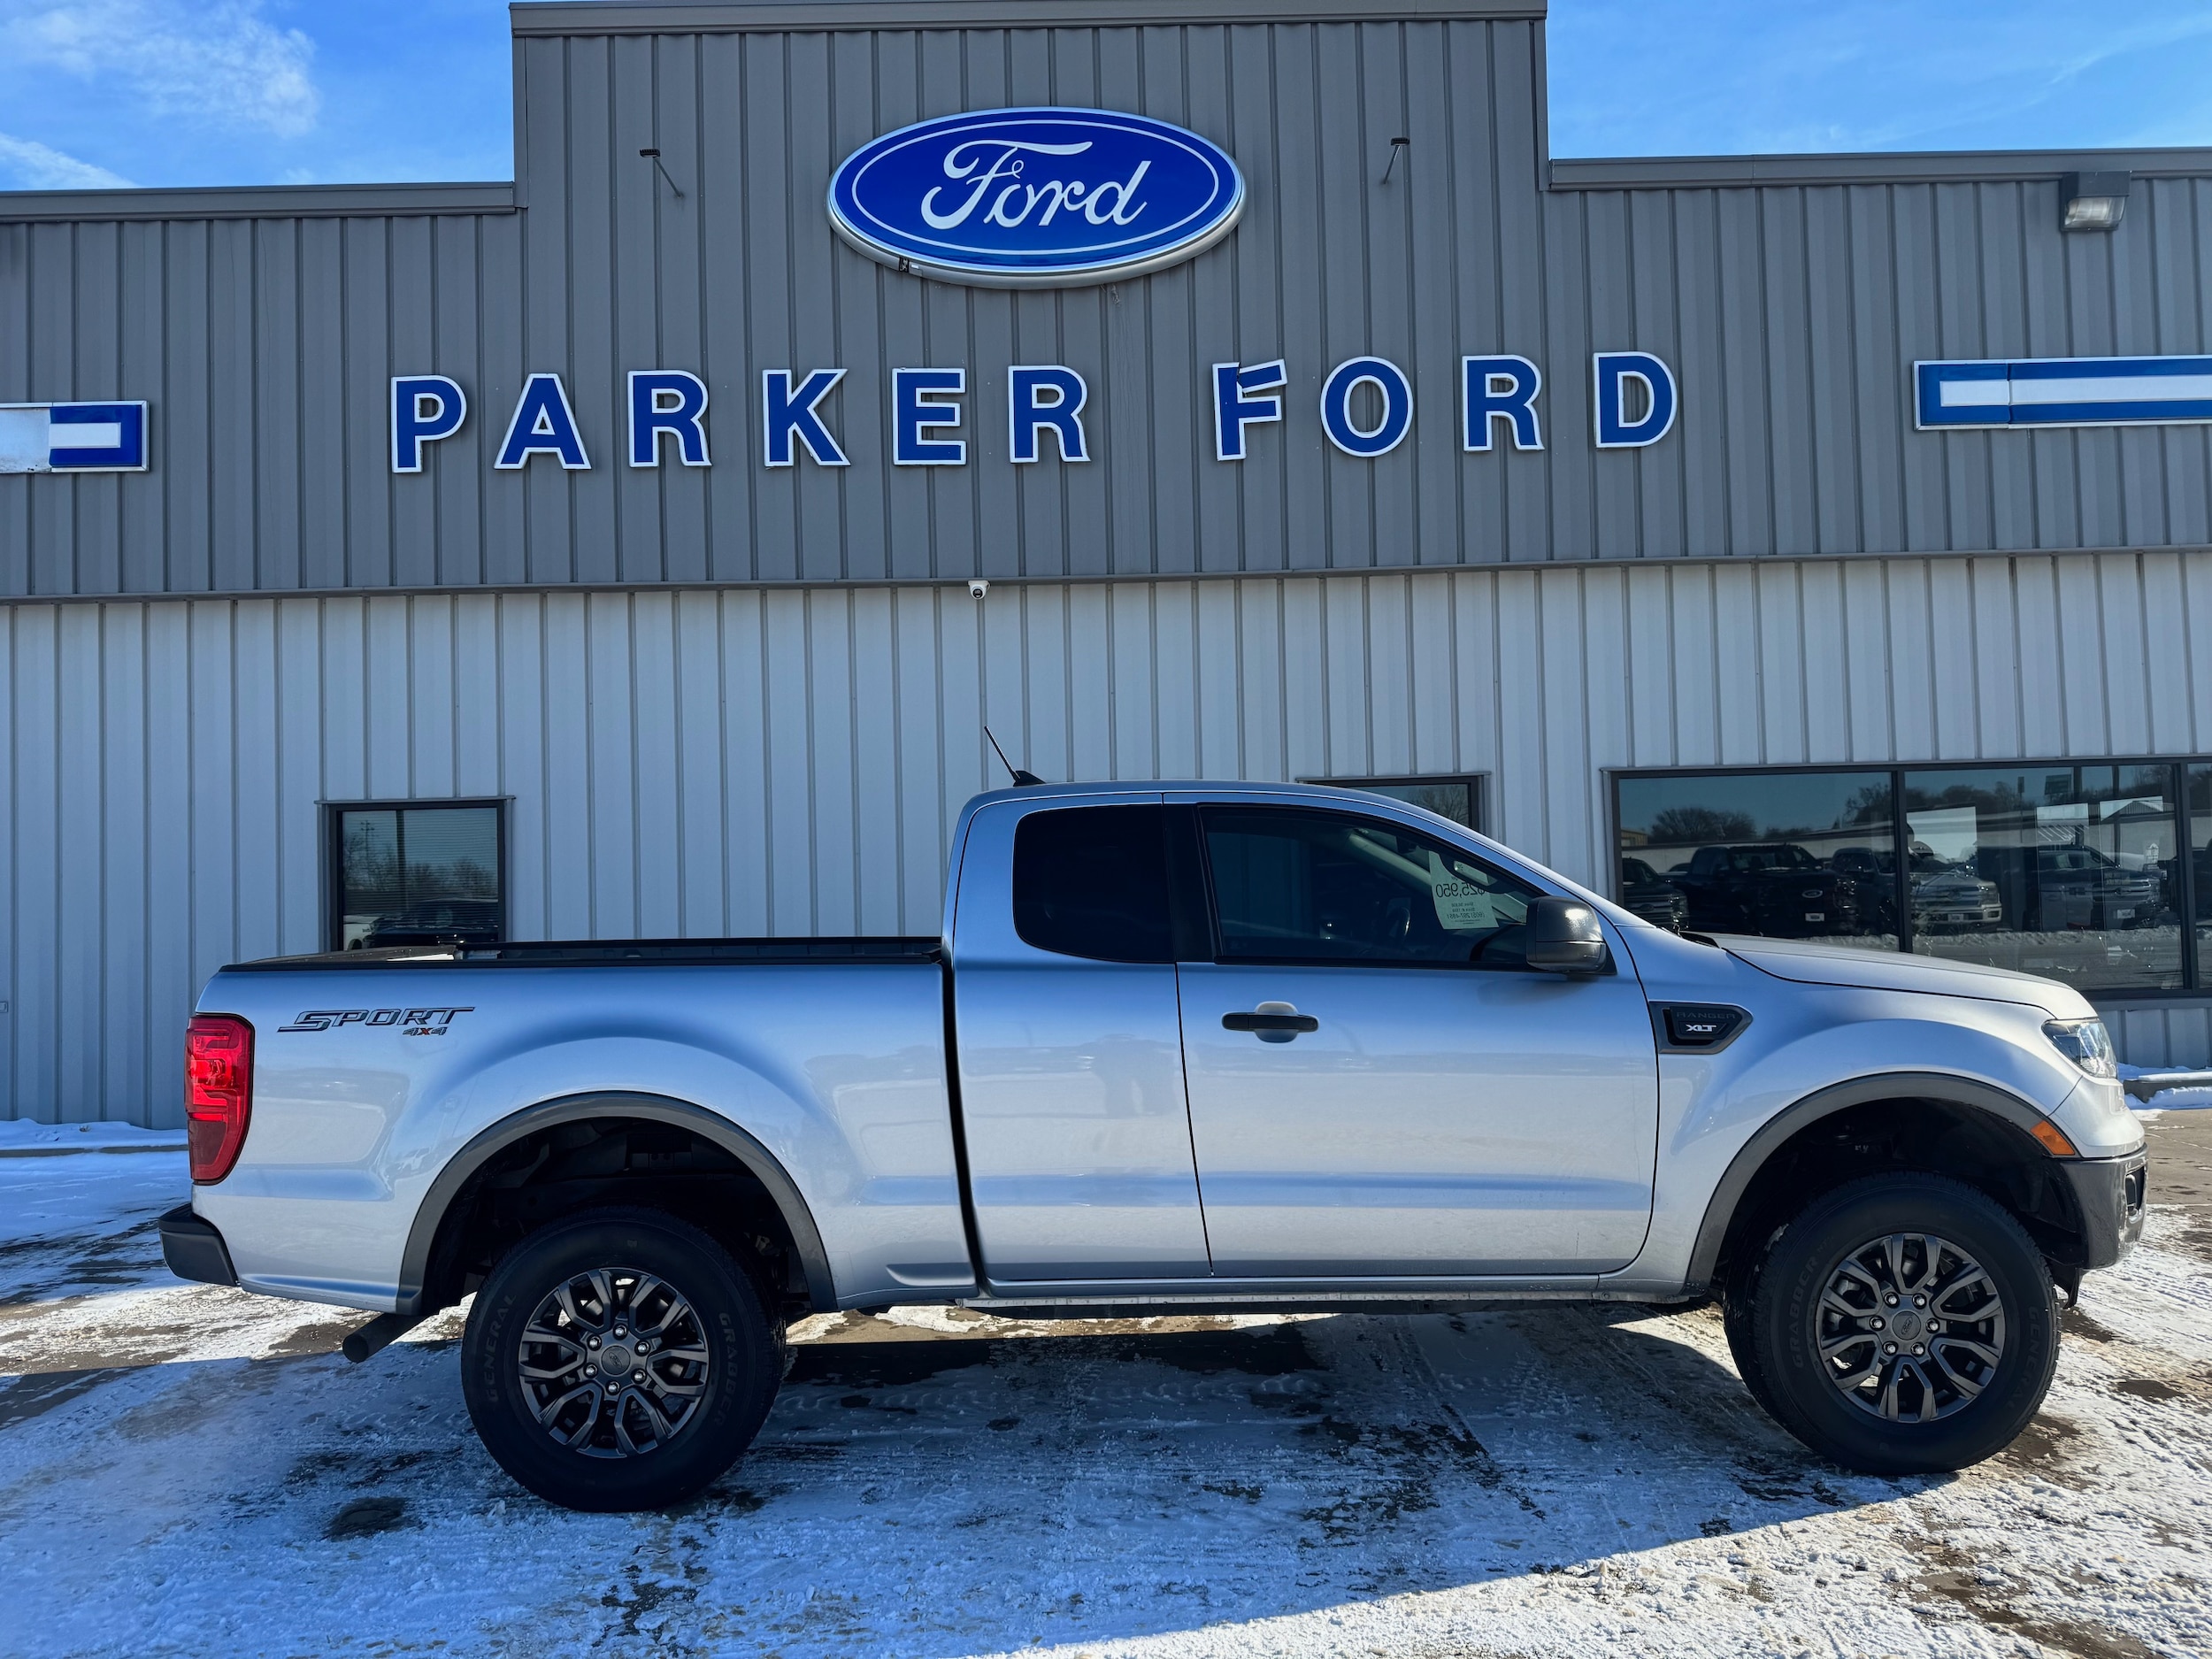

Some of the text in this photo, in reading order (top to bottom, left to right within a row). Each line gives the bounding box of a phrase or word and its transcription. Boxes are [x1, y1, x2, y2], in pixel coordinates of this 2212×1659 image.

[920, 139, 1152, 230] Ford
[390, 350, 1678, 474] PARKER FORD
[276, 1006, 475, 1033] SPORT
[1676, 1010, 1736, 1019] RANGER
[1685, 1023, 1717, 1033] XLT
[483, 1294, 517, 1402] GENERAL
[1788, 1255, 1820, 1370] GRABBER
[2003, 1305, 2040, 1409] GENERAL
[713, 1311, 739, 1427] GRABBER
